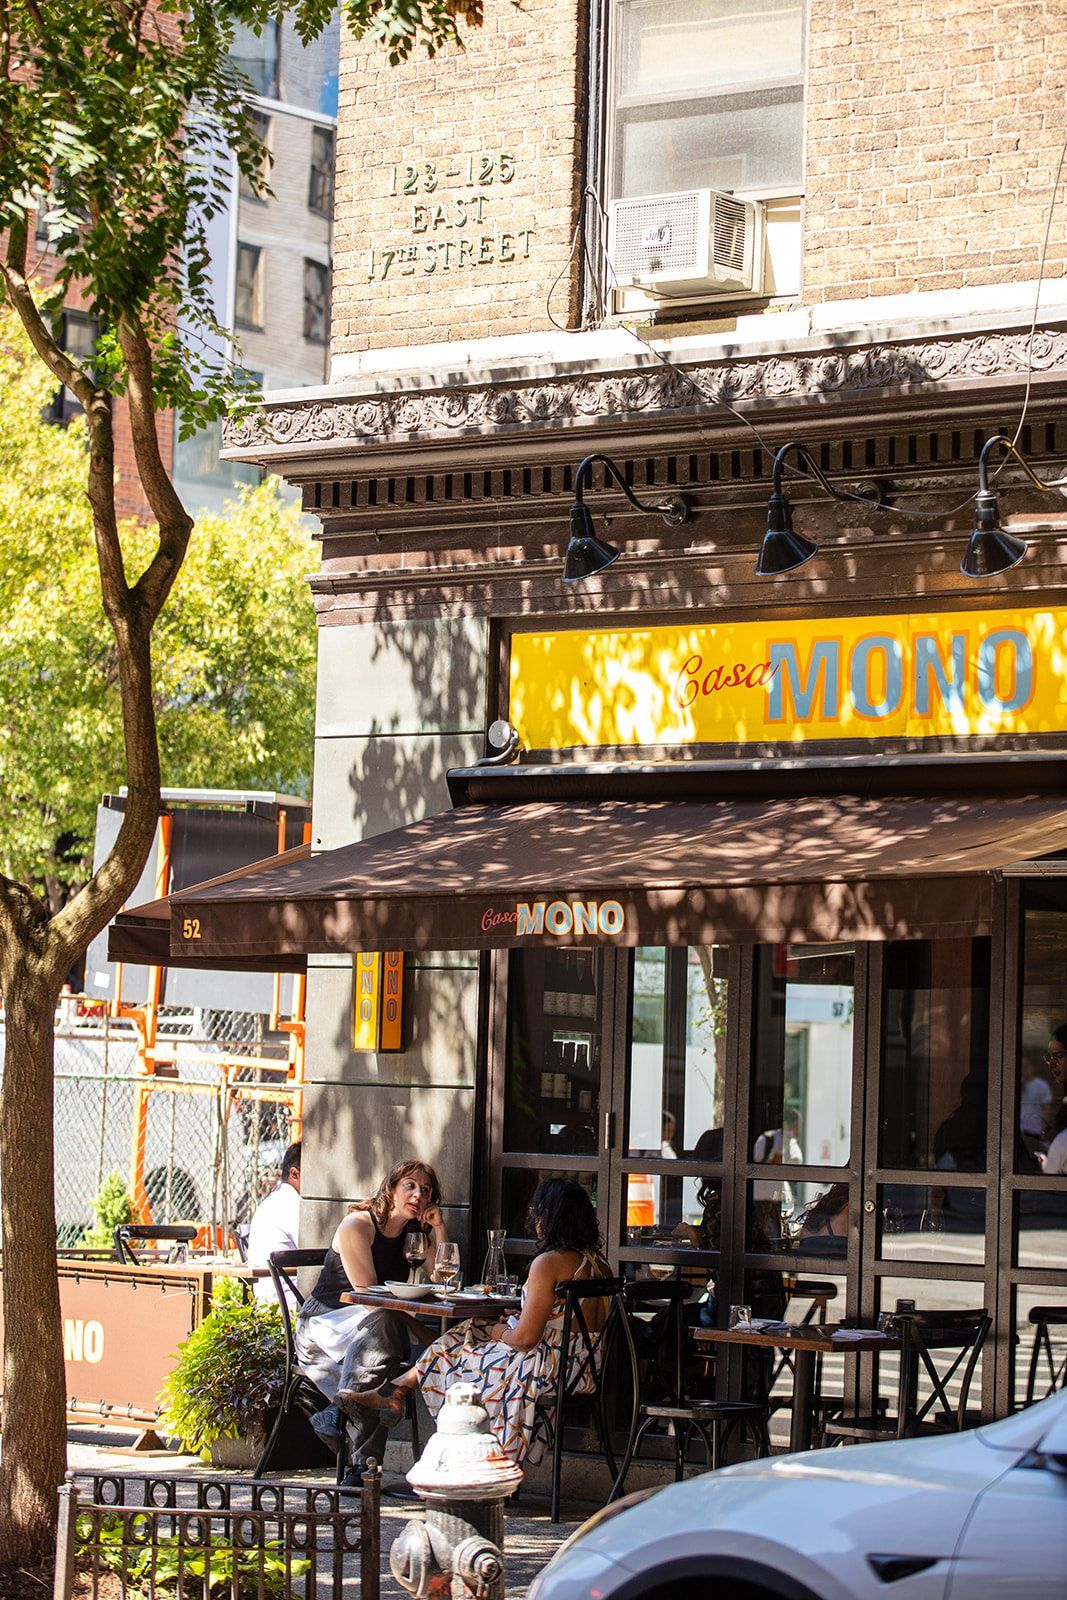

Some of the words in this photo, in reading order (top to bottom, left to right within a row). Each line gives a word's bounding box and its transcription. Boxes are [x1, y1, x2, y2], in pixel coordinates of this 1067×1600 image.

[389, 154, 515, 197] 123-125
[412, 196, 490, 234] EAST
[424, 230, 537, 274] STREET
[674, 654, 780, 709] Casa
[763, 625, 1038, 725] MONO
[183, 918, 202, 939] 52
[481, 907, 519, 931] Casa
[515, 900, 625, 936] MONO
